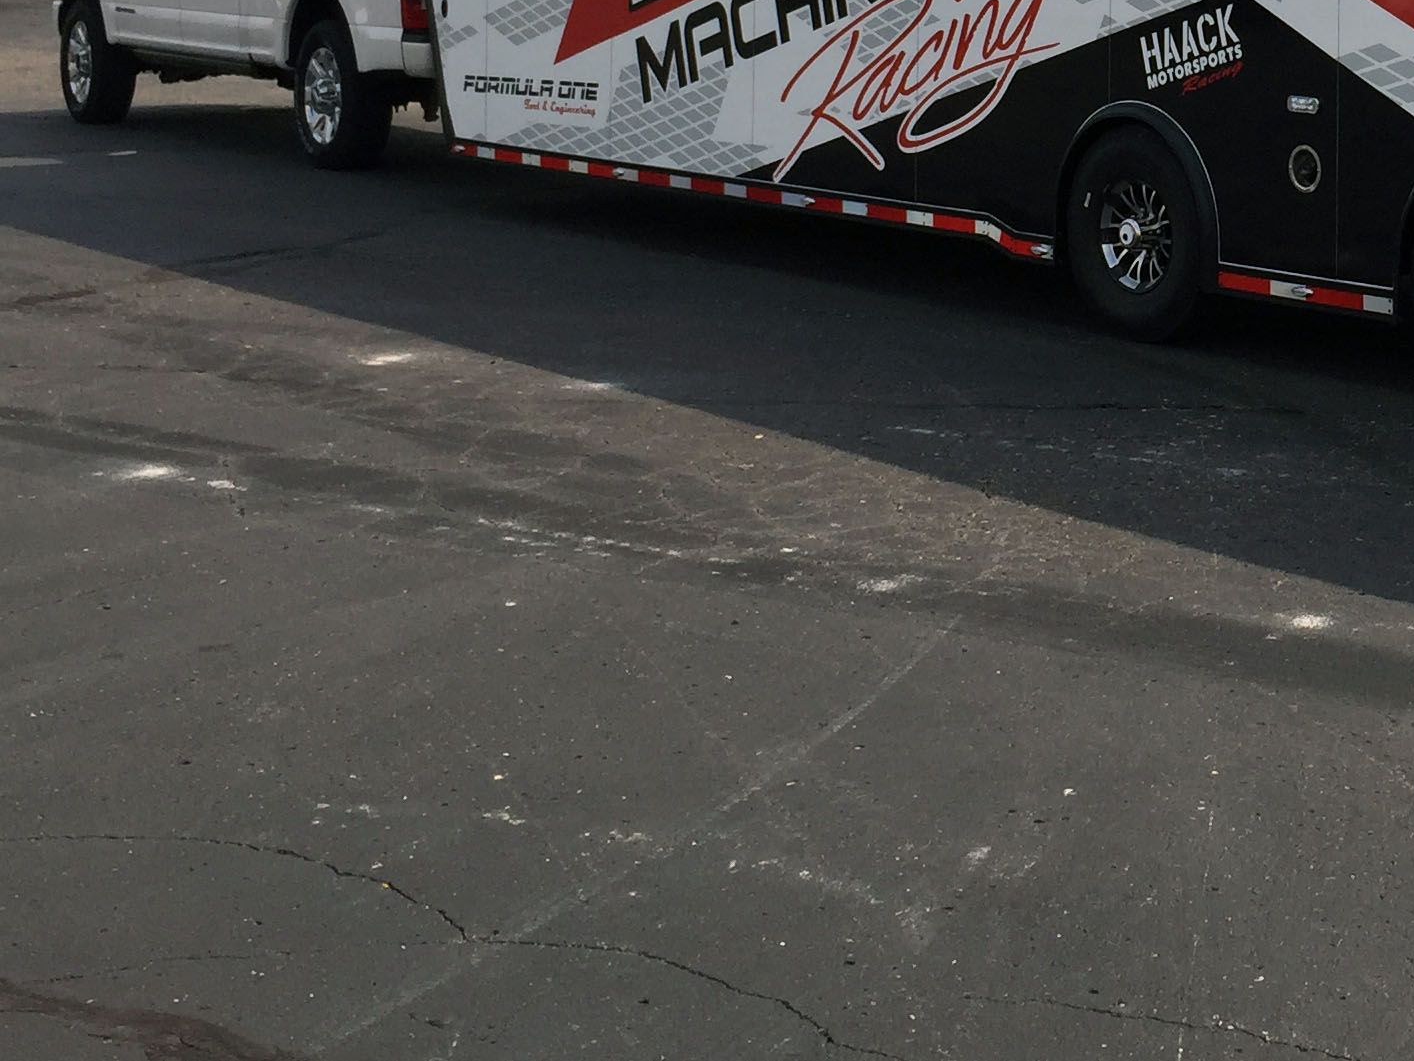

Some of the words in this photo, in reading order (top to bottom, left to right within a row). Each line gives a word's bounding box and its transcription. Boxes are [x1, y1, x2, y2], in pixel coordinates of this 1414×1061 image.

[1140, 3, 1240, 74] HAACK
[1146, 43, 1243, 90] MOTORSPORTS
[1180, 60, 1244, 96] Racing
[463, 74, 554, 98] FORMULA
[557, 80, 599, 101] ONE
